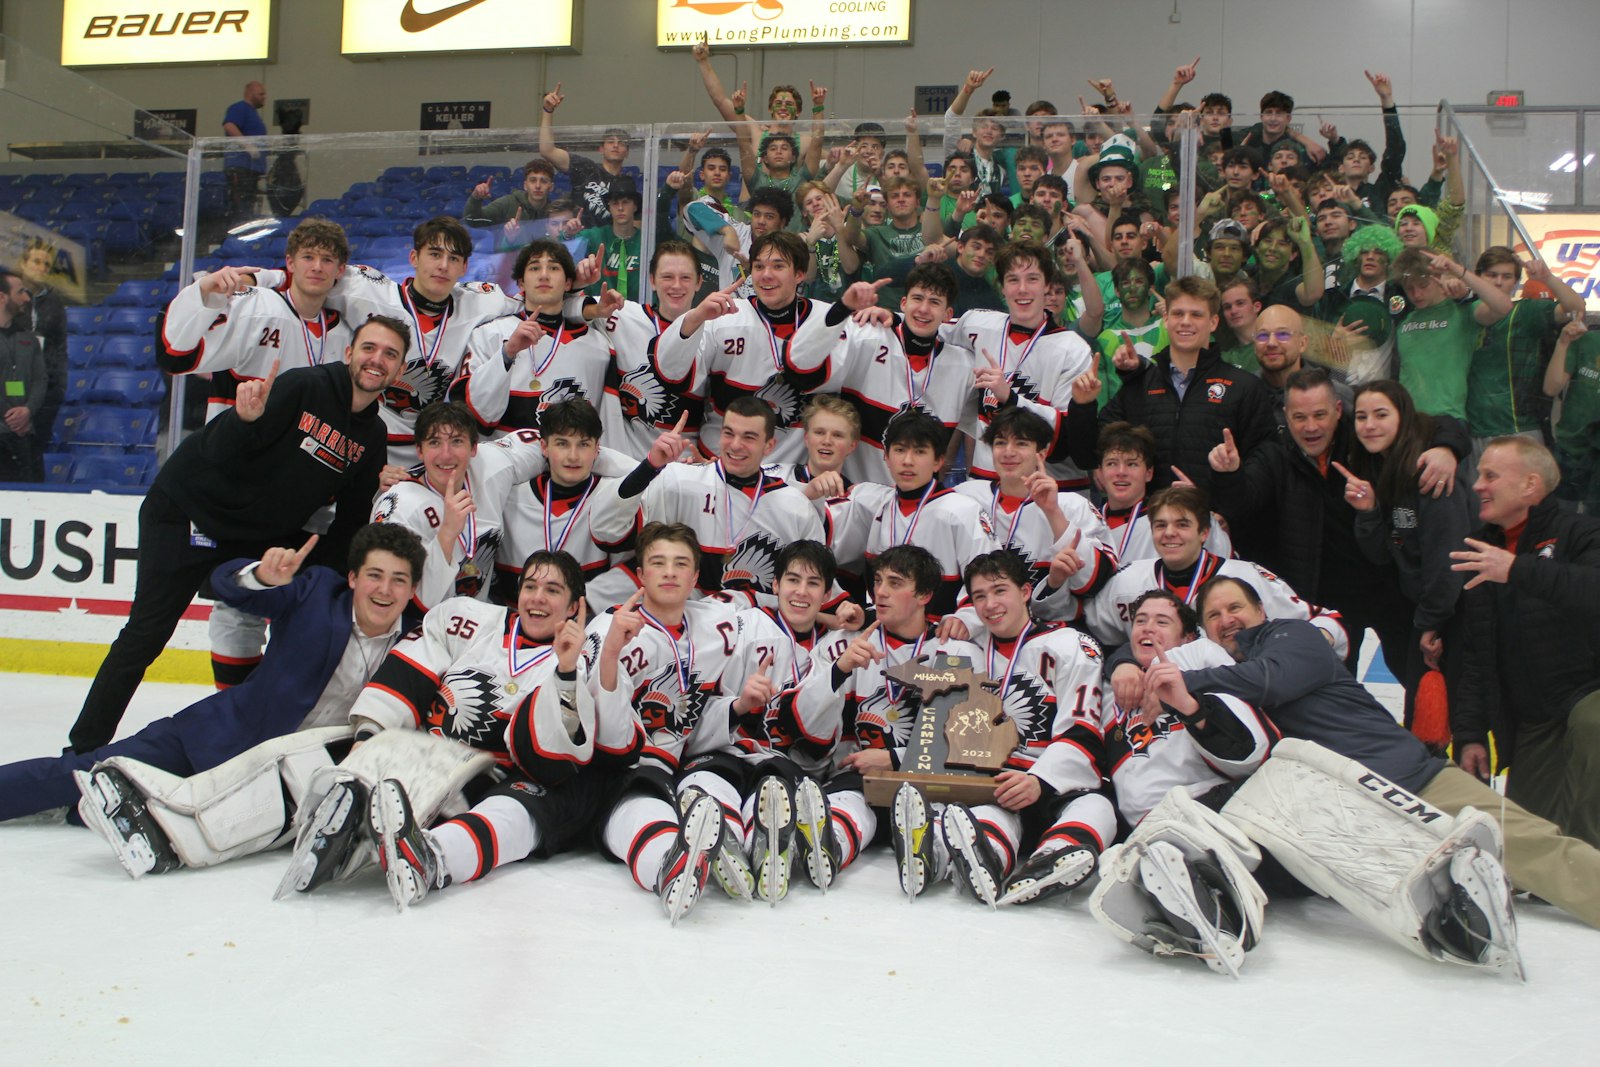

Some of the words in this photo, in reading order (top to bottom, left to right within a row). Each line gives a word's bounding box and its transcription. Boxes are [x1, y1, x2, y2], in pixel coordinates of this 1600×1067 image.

[829, 1, 887, 13] COOLING
[666, 25, 899, 43] www.LongPlumbing.com
[926, 96, 948, 112] 111
[435, 113, 475, 122] KELLER
[258, 327, 280, 349] 24
[724, 337, 745, 356] 28
[968, 333, 978, 350] 7
[875, 345, 889, 365] 2
[424, 506, 440, 528] 8
[446, 615, 479, 640] 35
[716, 621, 736, 657] C
[827, 638, 849, 661] 10
[620, 647, 649, 677] 22
[917, 707, 936, 770] CHAMPION
[961, 750, 992, 758] 2023
[1358, 771, 1442, 824] CCM
